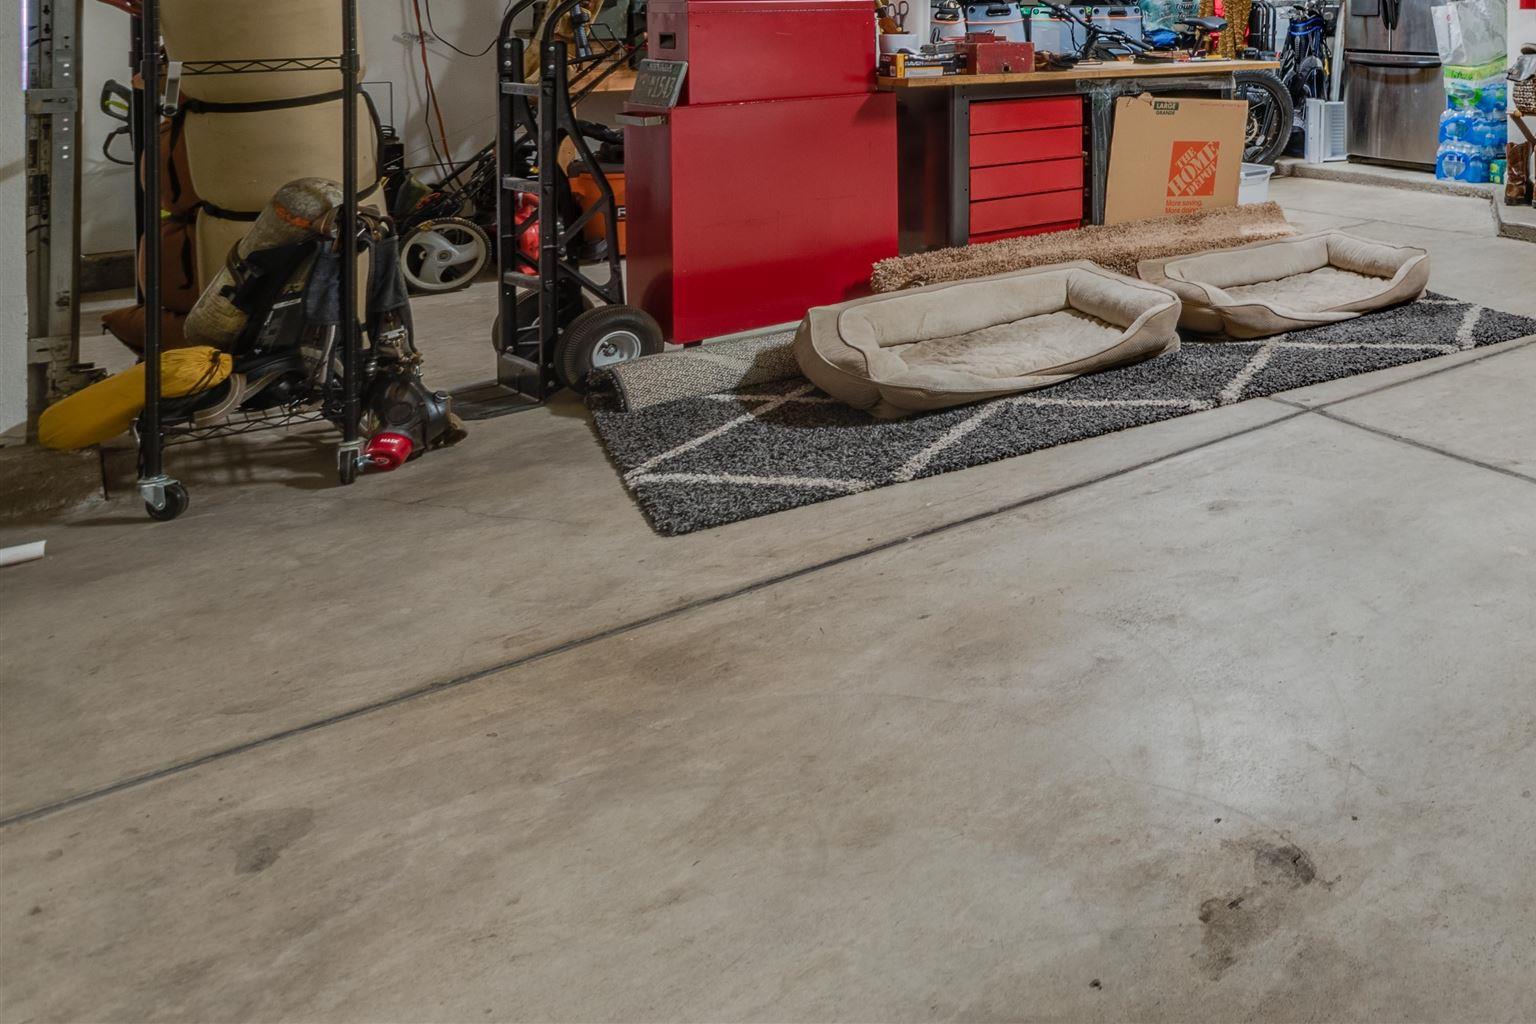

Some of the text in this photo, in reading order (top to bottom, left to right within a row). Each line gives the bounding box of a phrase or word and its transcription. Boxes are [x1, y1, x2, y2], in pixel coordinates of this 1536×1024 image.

[1168, 140, 1219, 196] HOME
[1175, 146, 1197, 169] THE
[1185, 161, 1218, 196] DEPOT
